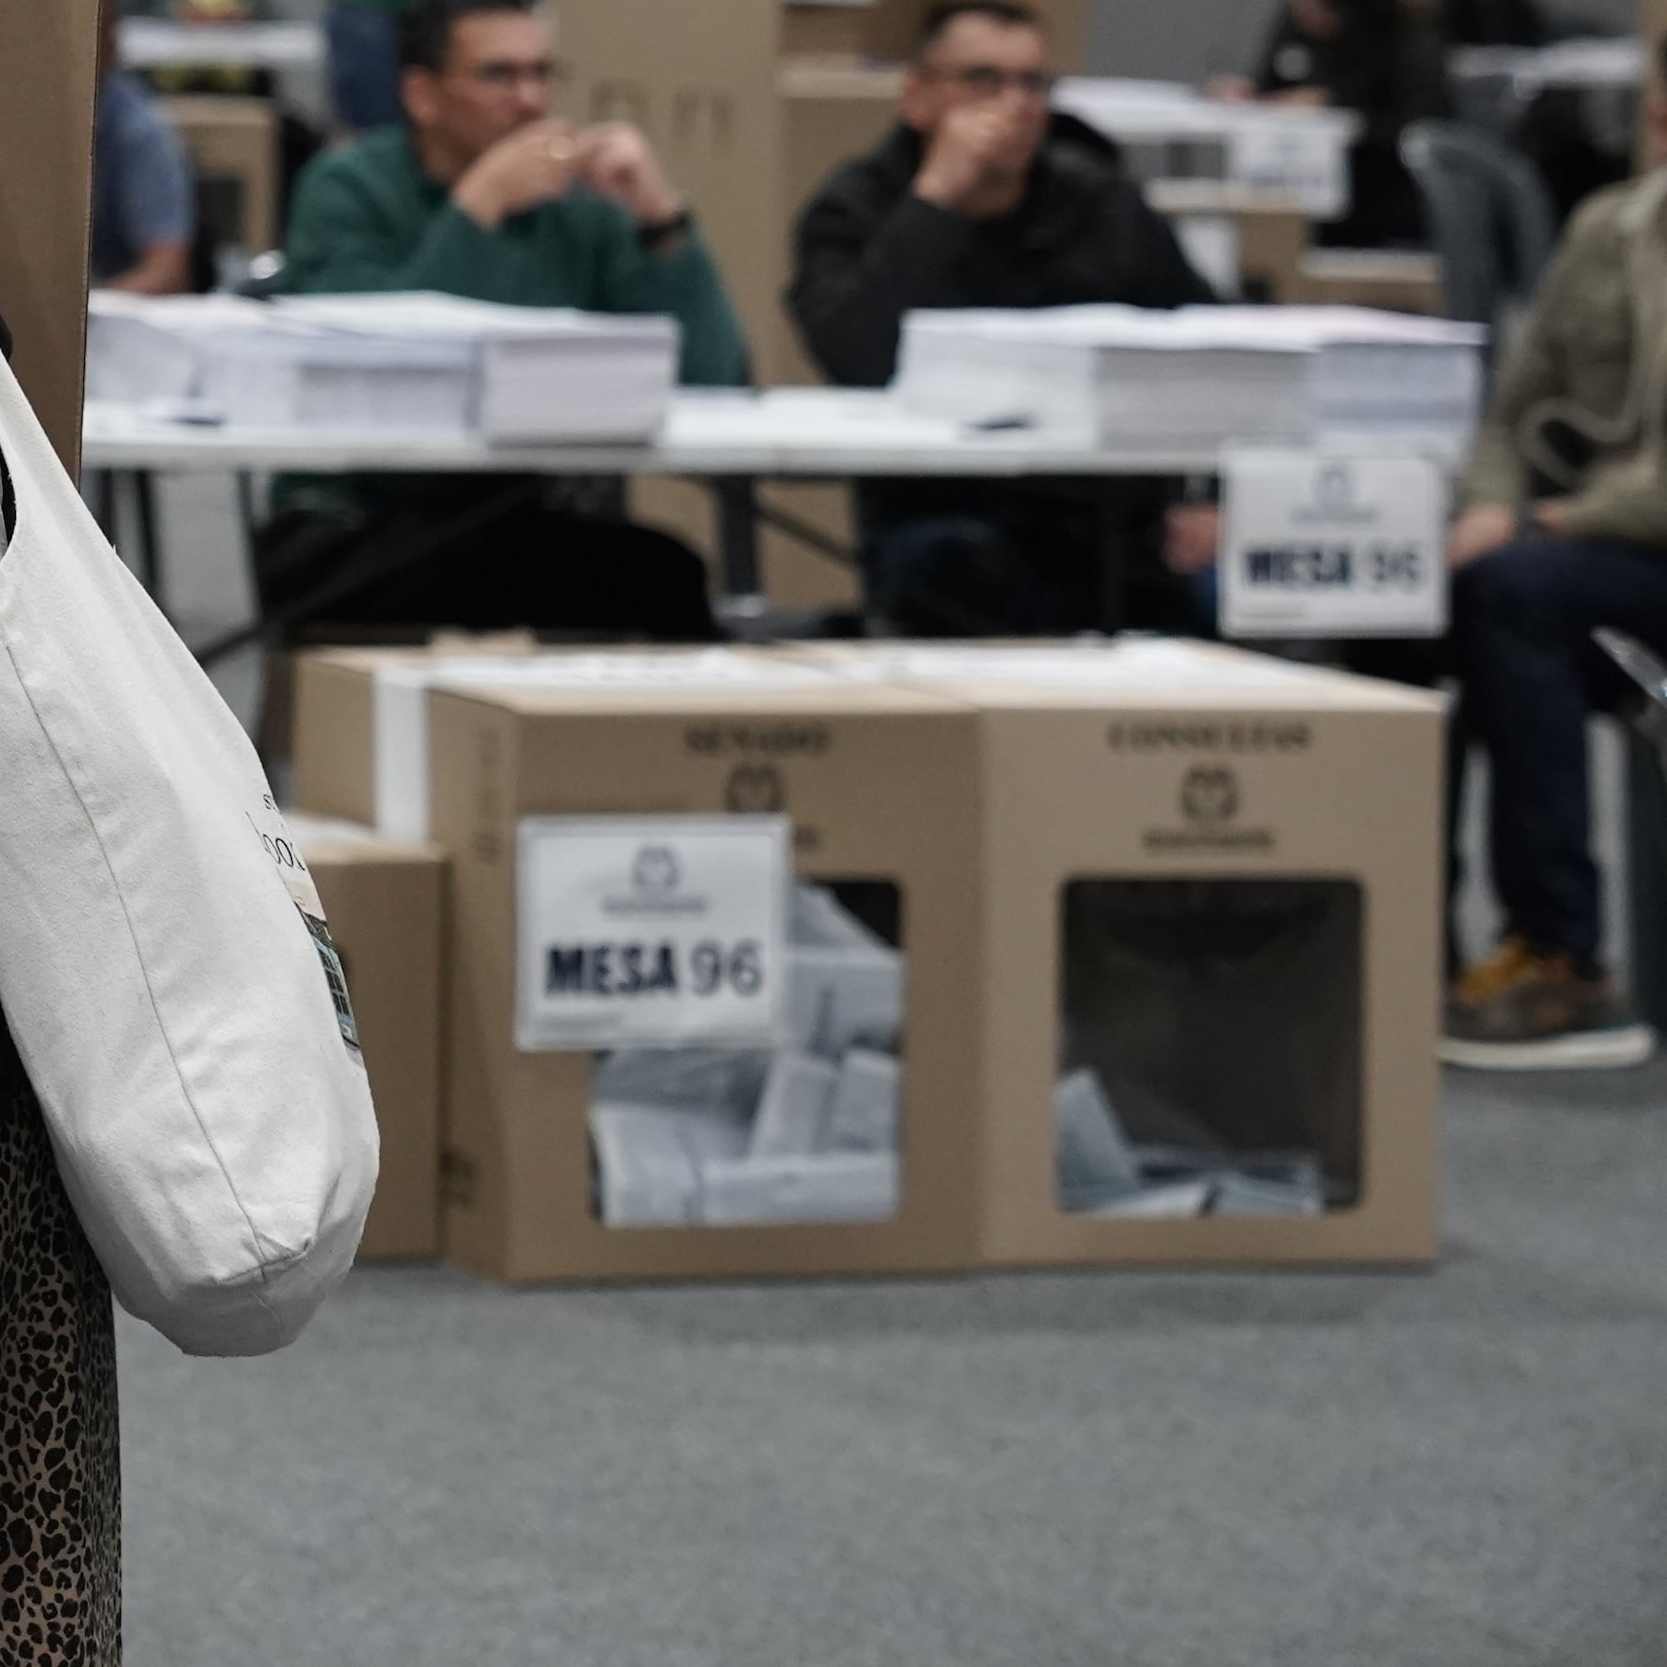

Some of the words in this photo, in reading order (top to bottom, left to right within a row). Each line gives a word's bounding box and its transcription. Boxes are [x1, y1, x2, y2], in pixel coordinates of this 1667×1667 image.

[1244, 547, 1351, 589] MESA
[543, 940, 679, 996] MESA
[689, 937, 763, 998] 96
